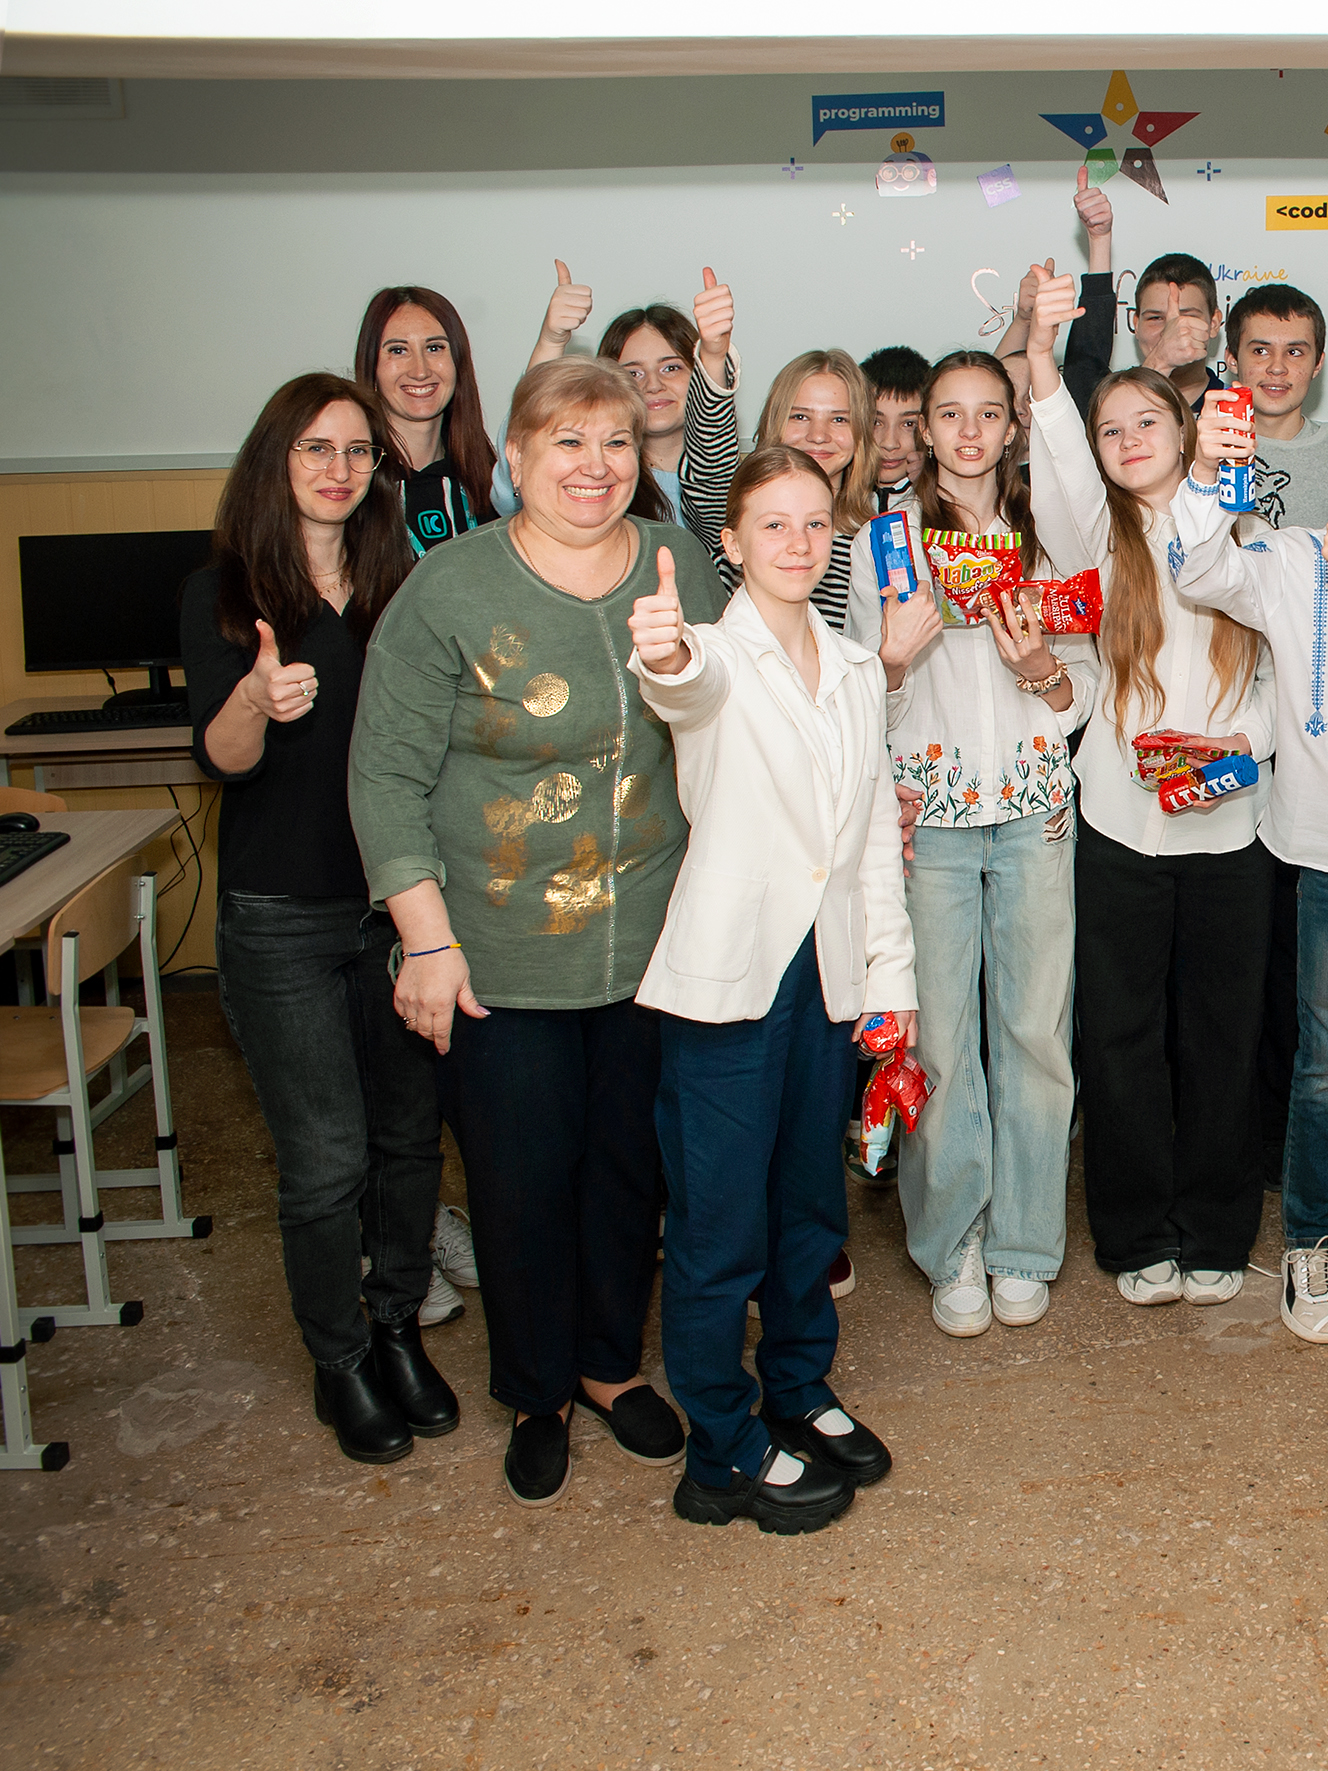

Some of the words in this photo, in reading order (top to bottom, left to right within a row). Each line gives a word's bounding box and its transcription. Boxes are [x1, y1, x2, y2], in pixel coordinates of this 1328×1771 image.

[818, 102, 940, 122] programming
[1208, 263, 1289, 282] Ukraine
[1168, 772, 1242, 811] BIXIT
